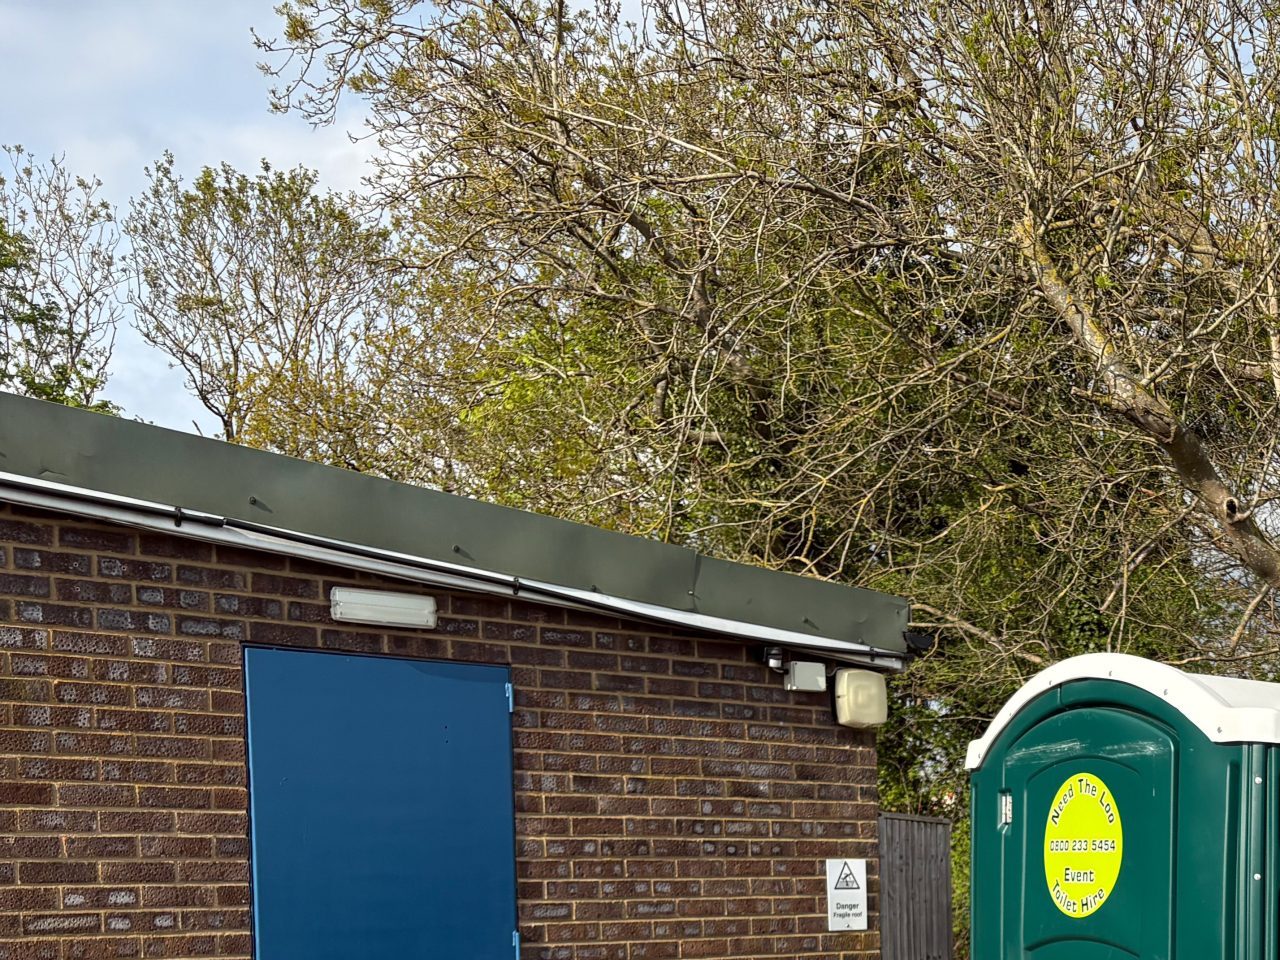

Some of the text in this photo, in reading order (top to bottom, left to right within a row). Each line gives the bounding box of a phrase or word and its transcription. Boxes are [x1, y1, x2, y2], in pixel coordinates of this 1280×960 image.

[1051, 778, 1115, 825] Need The Loo
[1050, 839, 1116, 852] 0800 233 5454
[1064, 867, 1094, 882] Event
[1052, 880, 1105, 912] Toilet Hire
[836, 902, 859, 911] Danger
